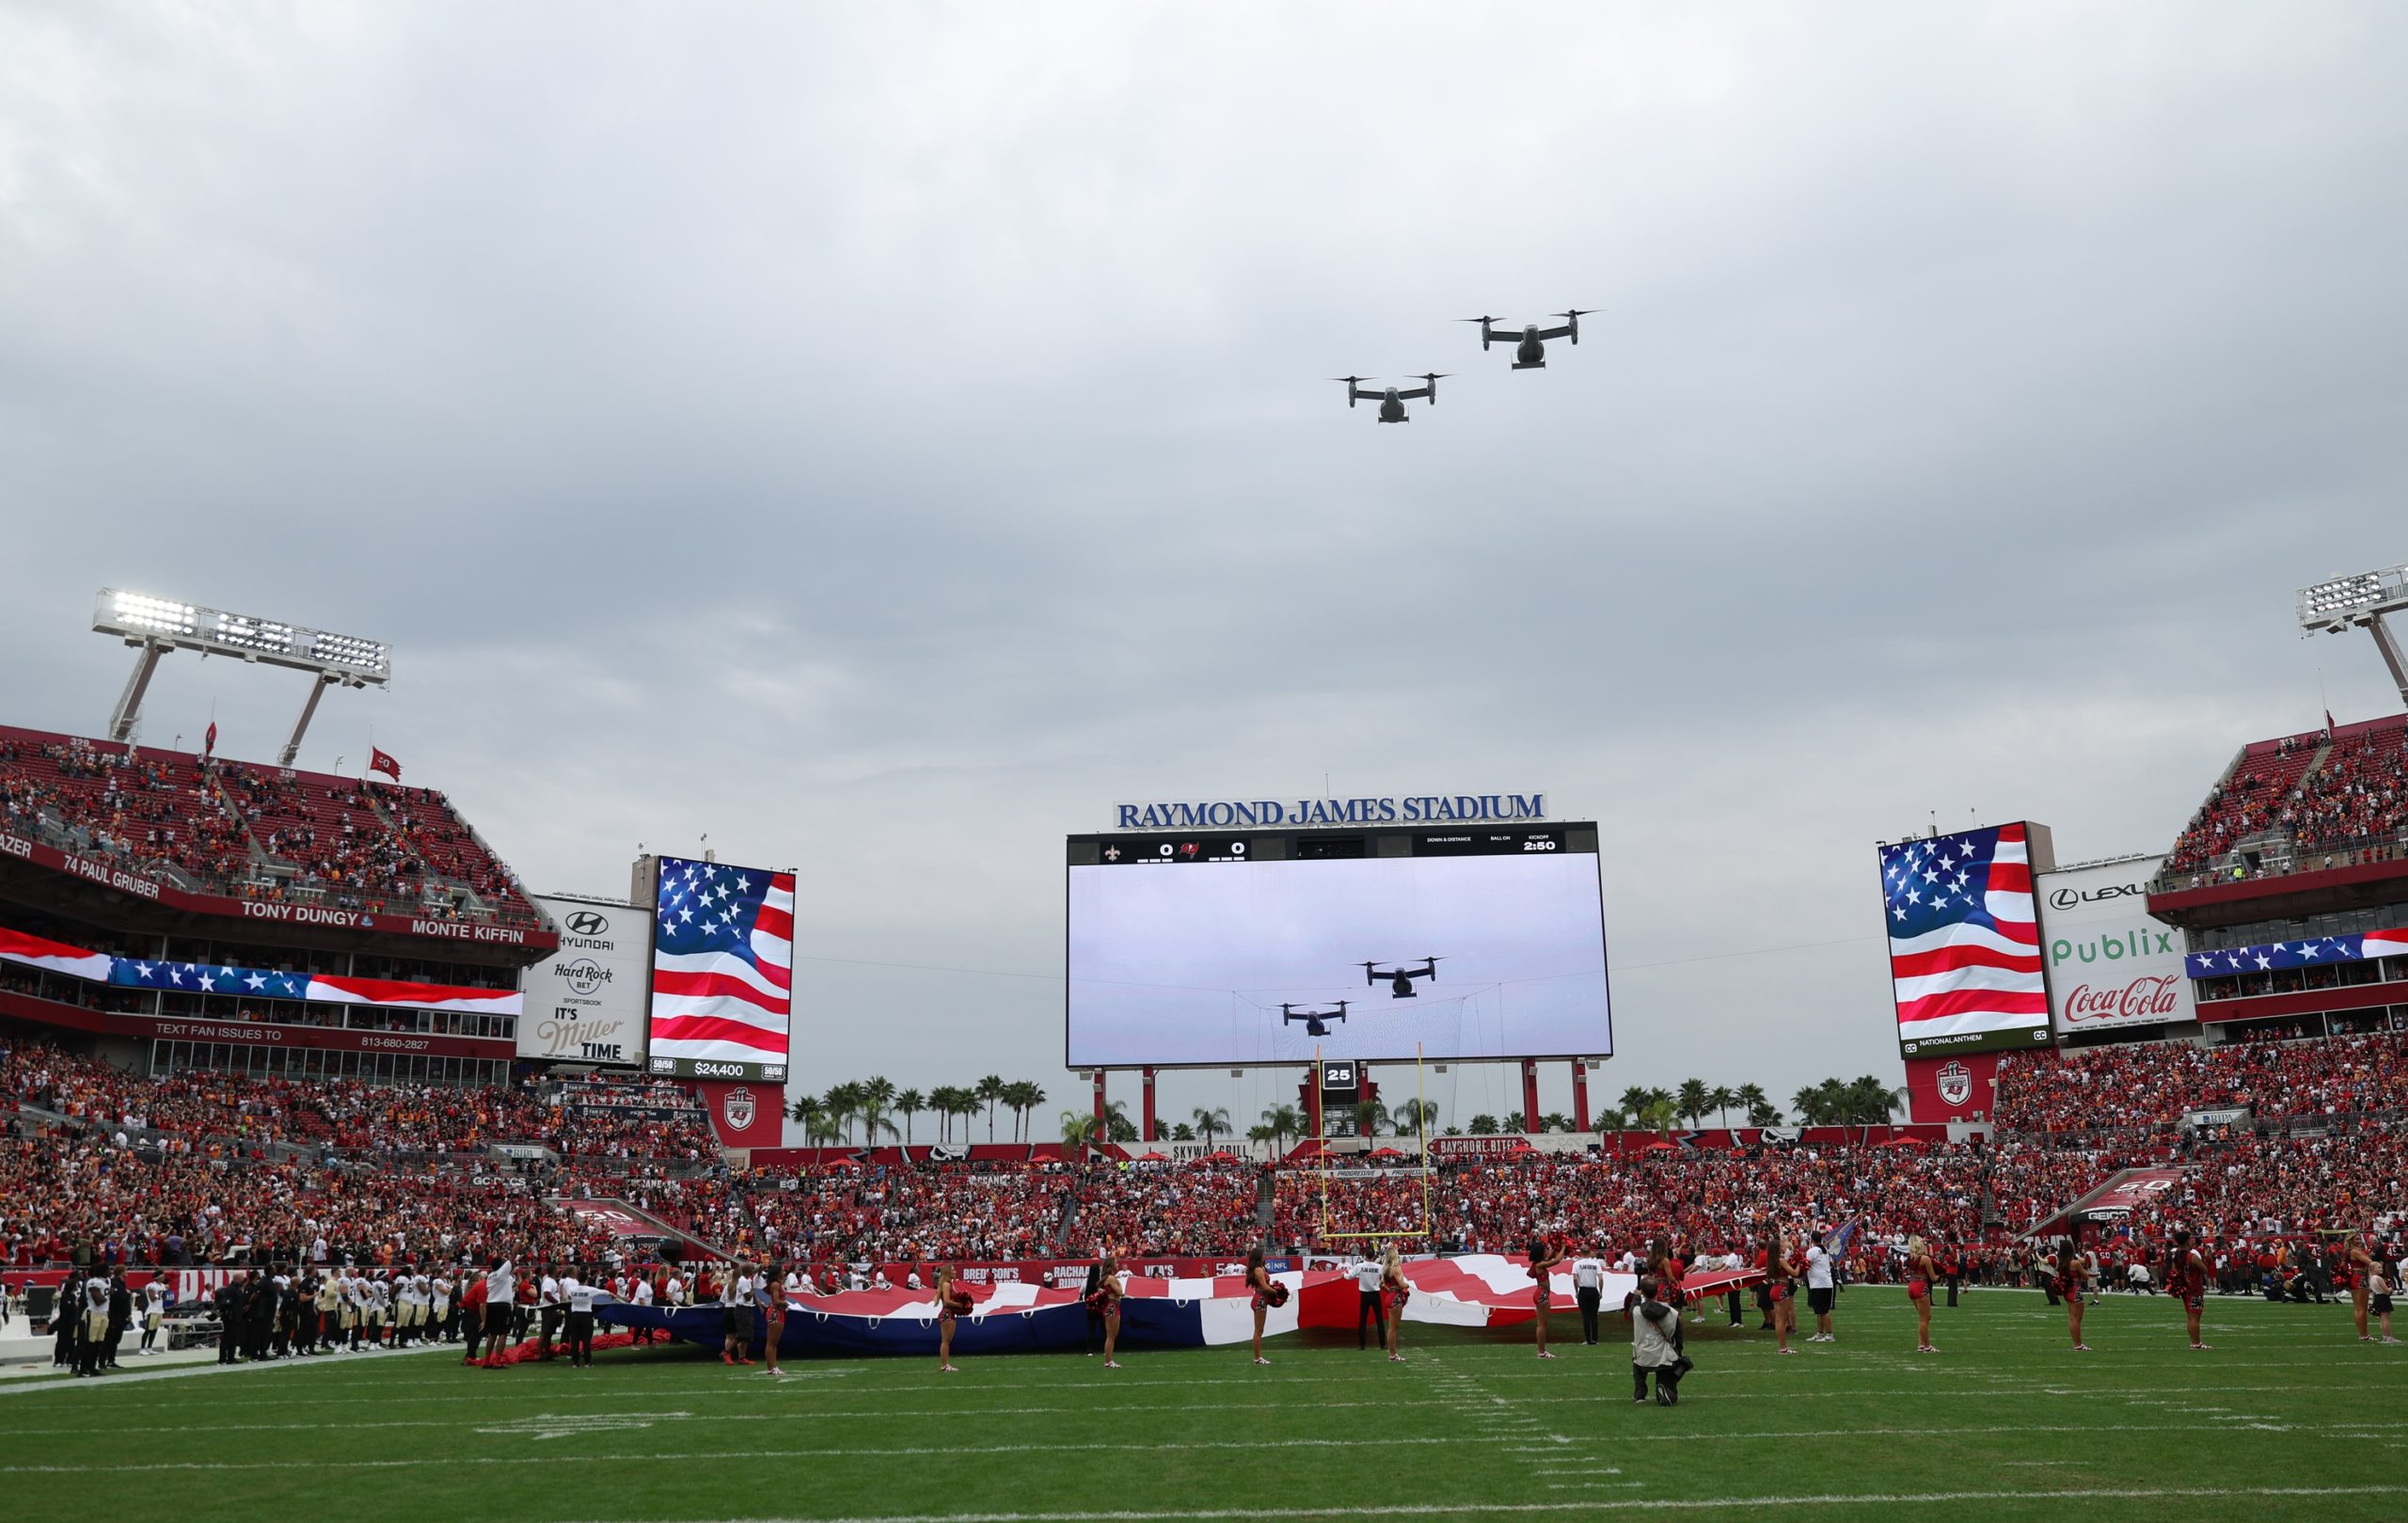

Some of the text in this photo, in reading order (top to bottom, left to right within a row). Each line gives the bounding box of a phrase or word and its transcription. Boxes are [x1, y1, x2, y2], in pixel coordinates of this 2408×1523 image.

[279, 769, 296, 778] 328
[1117, 794, 1544, 827] RAYMOND JAMES STADIUM
[1160, 844, 1173, 855] 0
[1231, 842, 1245, 854] 0
[1524, 842, 1556, 850] 2:50
[64, 855, 159, 899] 74 PAUL GRUBER
[2082, 884, 2145, 901] LEXU
[242, 901, 358, 927] TONY DUNGY
[412, 920, 524, 944] MONTE KIFFIN
[560, 937, 614, 951] HYUNDAI
[555, 963, 612, 983] Hard Rock
[563, 998, 602, 1007] SPORTSBOOK
[2065, 975, 2180, 1023] Coca-Cola
[555, 1007, 578, 1021] IT'S
[155, 1023, 282, 1040] TEXT FAN ISSUES TO
[537, 1020, 625, 1055] Miller
[361, 1037, 429, 1050] 813-680-2827
[1920, 1034, 1982, 1046] NATIONAL ANTHEM
[581, 1043, 621, 1059] TIME
[653, 1059, 673, 1070] 50/50
[695, 1061, 744, 1076] $24,400
[764, 1067, 783, 1075] 50/50
[1327, 1070, 1351, 1081] 25
[1174, 1146, 1213, 1159] SKYWAY
[1441, 1140, 1487, 1153] BAYSHORE
[2115, 1180, 2172, 1192] 50
[2088, 1211, 2130, 1220] GEICO
